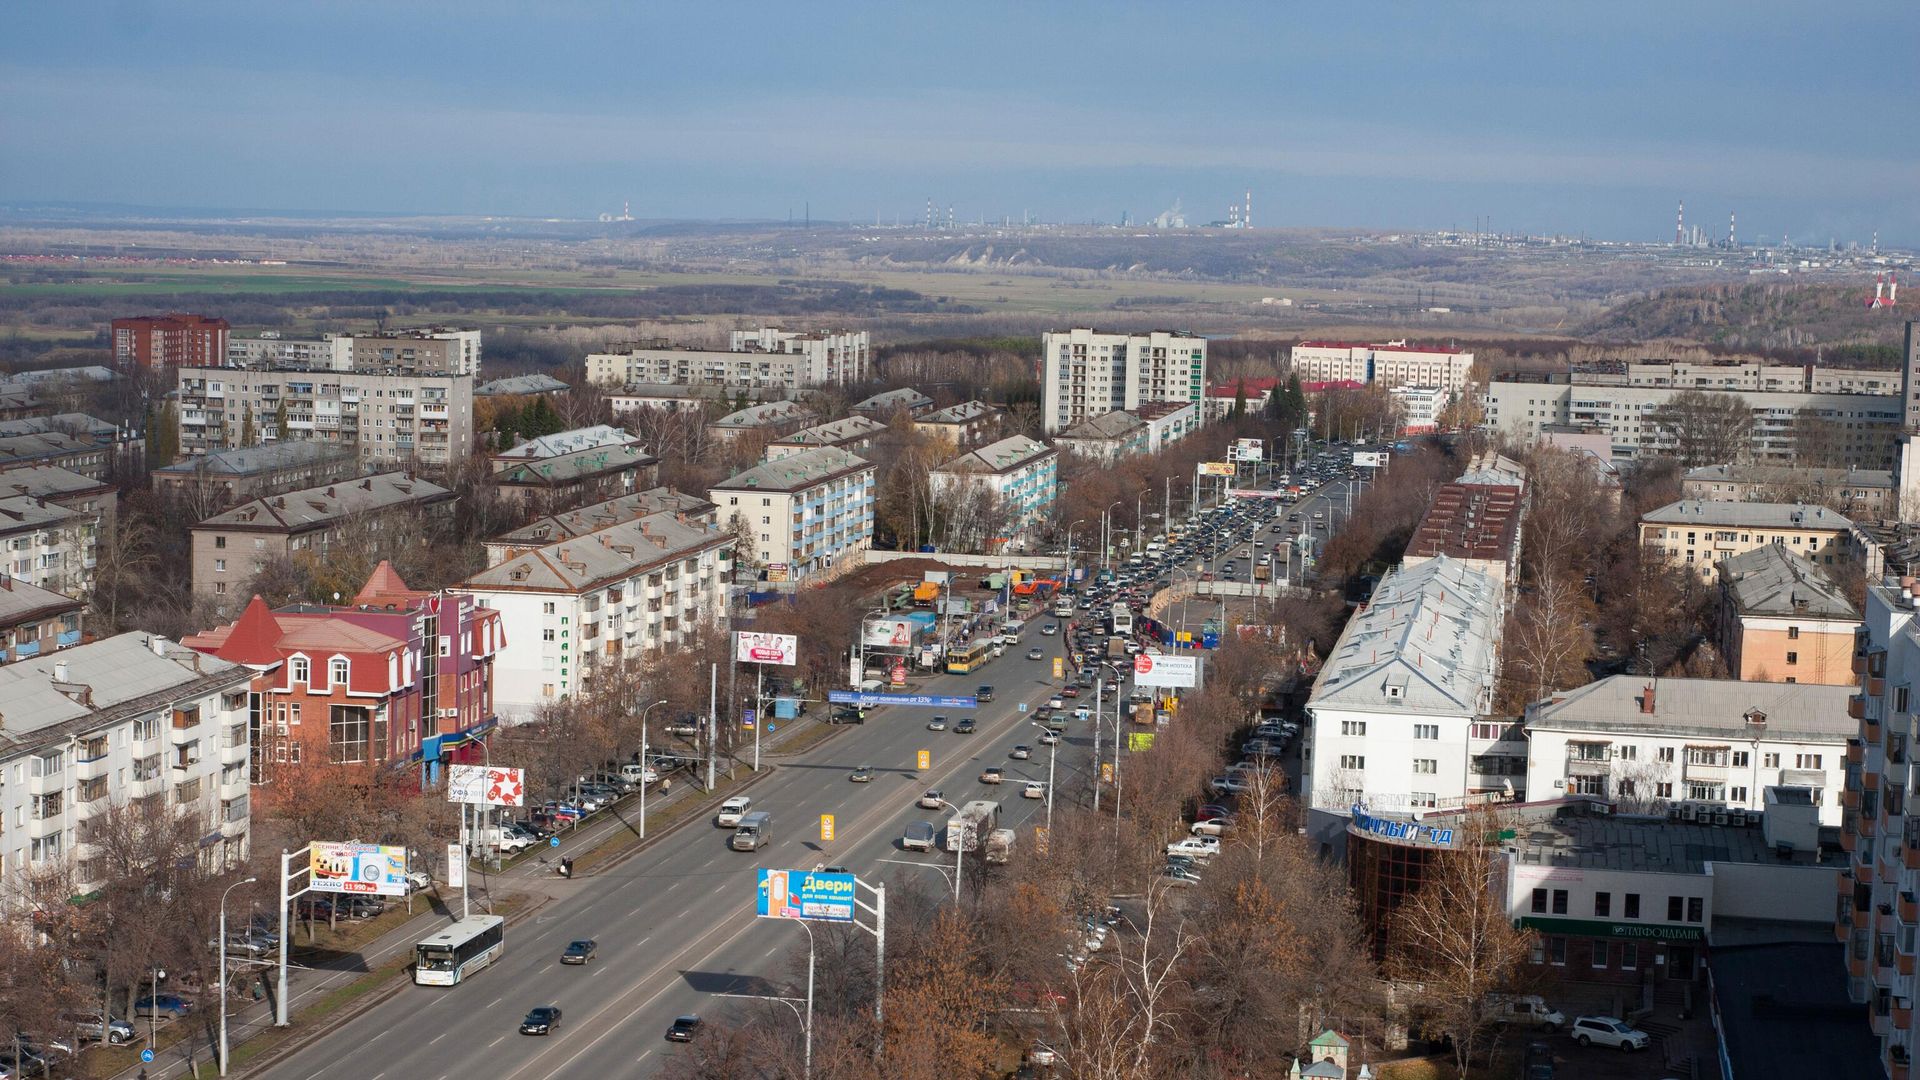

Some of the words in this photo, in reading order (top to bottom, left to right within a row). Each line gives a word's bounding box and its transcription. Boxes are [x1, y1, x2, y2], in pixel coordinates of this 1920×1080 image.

[1430, 828, 1453, 844] ТД
[312, 880, 342, 888] ТЕХНО
[802, 876, 852, 894] Двери
[1627, 926, 1701, 940] ТАТФОНДБАНК
